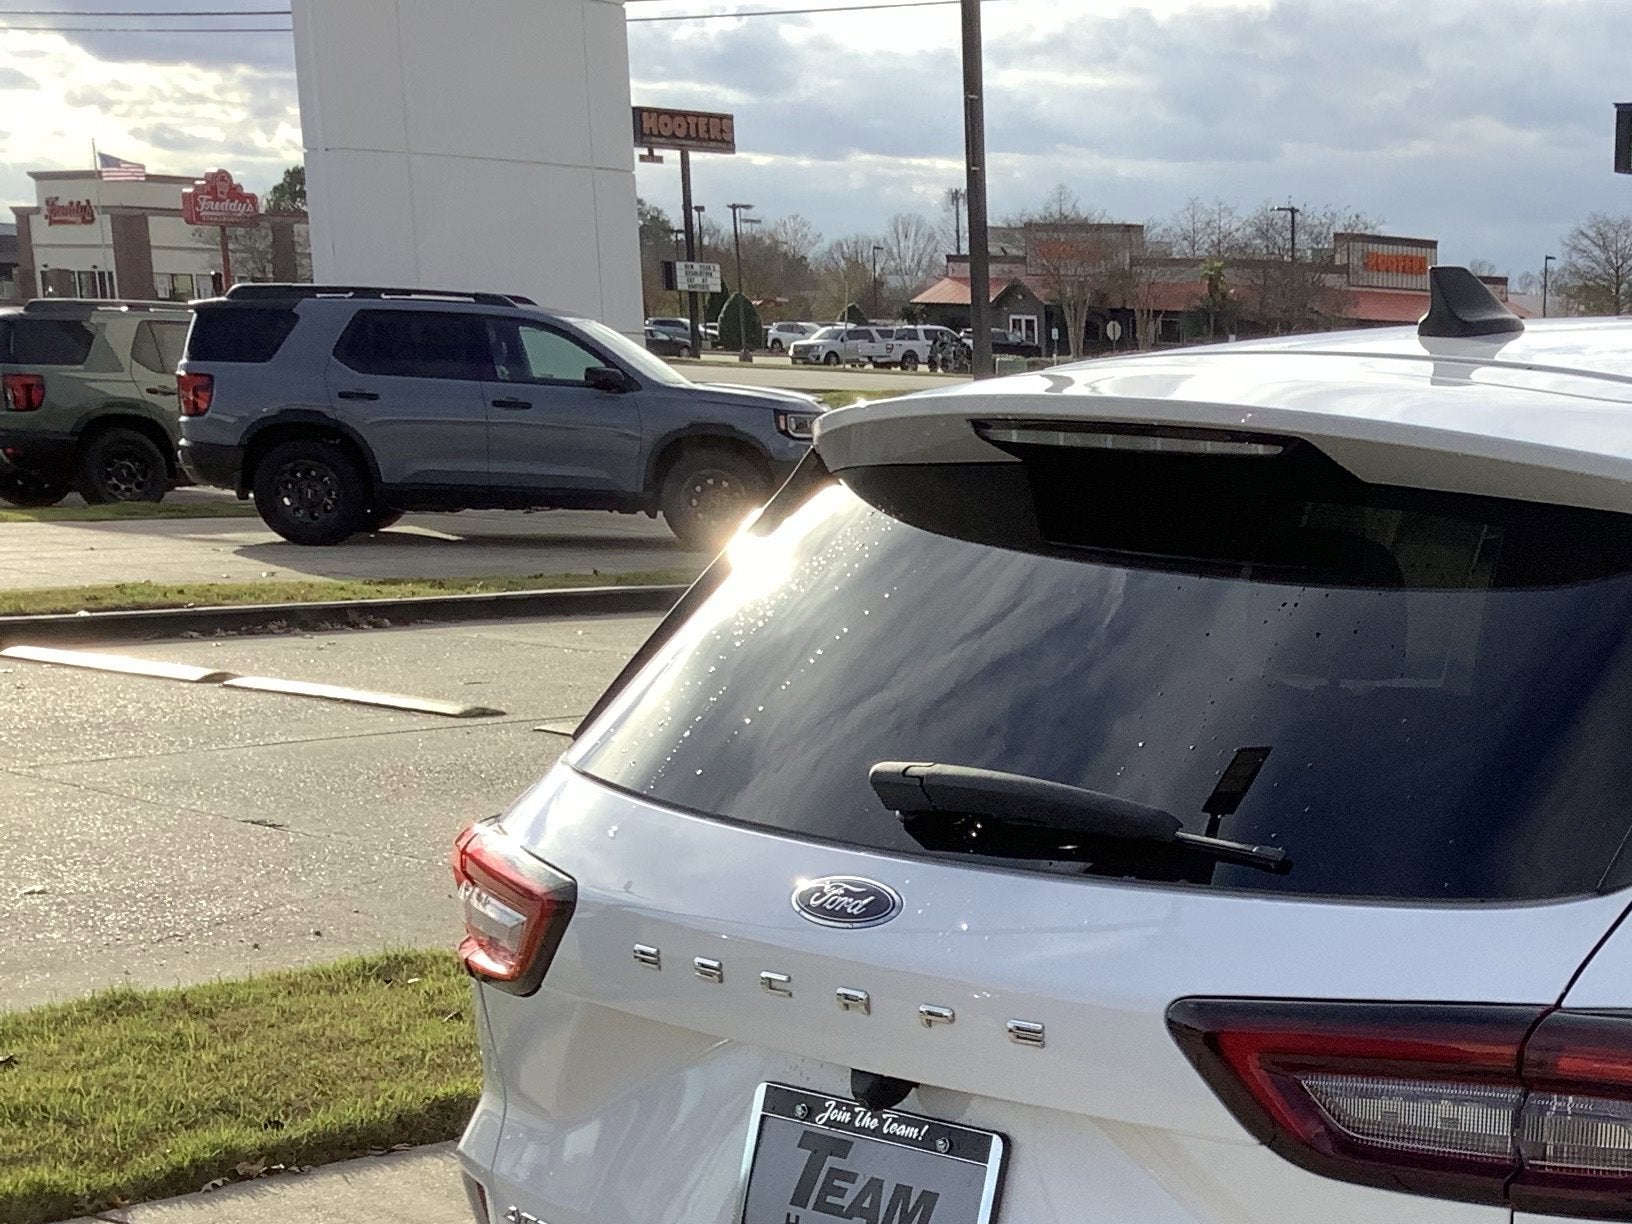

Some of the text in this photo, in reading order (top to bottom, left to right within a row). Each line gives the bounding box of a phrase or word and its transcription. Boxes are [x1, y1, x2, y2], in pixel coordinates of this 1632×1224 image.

[641, 111, 732, 141] HOOTERS
[196, 194, 255, 216] Freddy's
[809, 881, 876, 915] Ford
[633, 943, 1046, 1049] ESCAPE
[815, 1100, 930, 1141] Join The Team!
